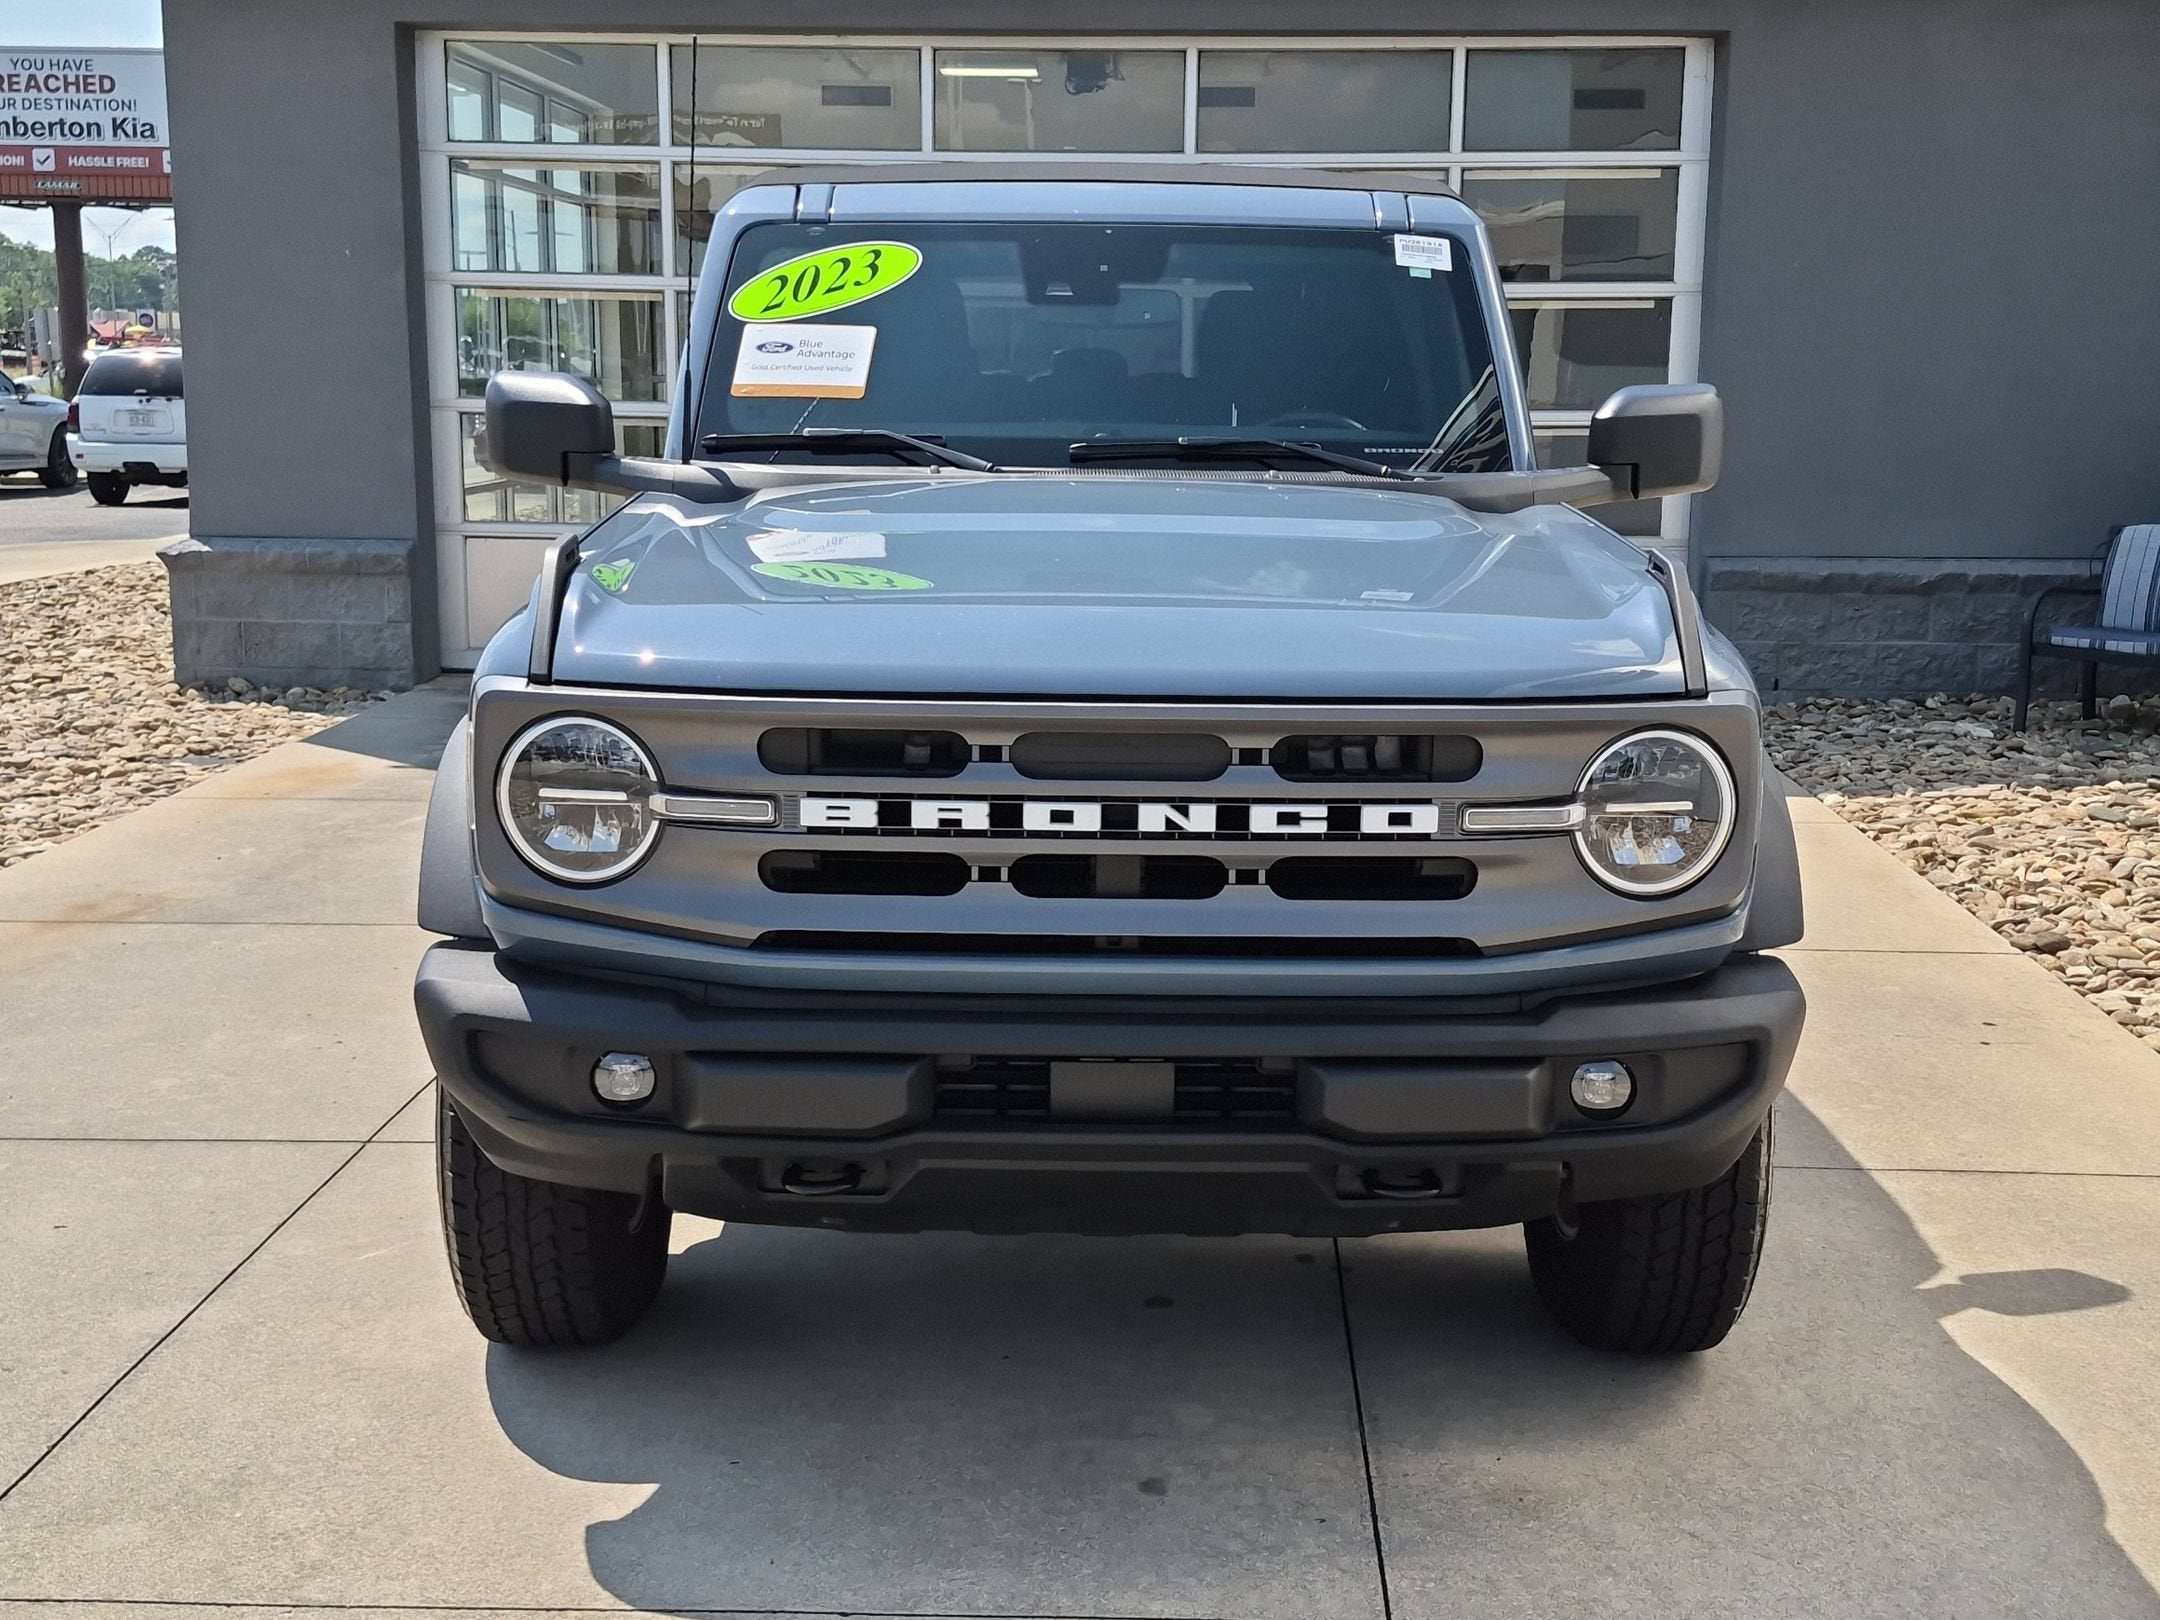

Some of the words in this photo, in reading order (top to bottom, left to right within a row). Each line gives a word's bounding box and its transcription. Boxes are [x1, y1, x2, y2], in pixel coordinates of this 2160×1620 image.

[9, 57, 45, 72] YOU
[50, 58, 94, 72] HAVE
[21, 97, 137, 112] DESTINATION!
[112, 116, 157, 139] Kia
[68, 155, 115, 168] HASSLE
[116, 156, 150, 168] FREE!
[760, 248, 883, 314] 2023
[798, 339, 824, 349] Blue
[796, 349, 856, 360] Advantage
[751, 363, 769, 371] Gold
[770, 363, 803, 372] Certified
[804, 364, 824, 372] Used
[825, 364, 854, 373] Vehicle
[800, 797, 1440, 836] BRONCO
